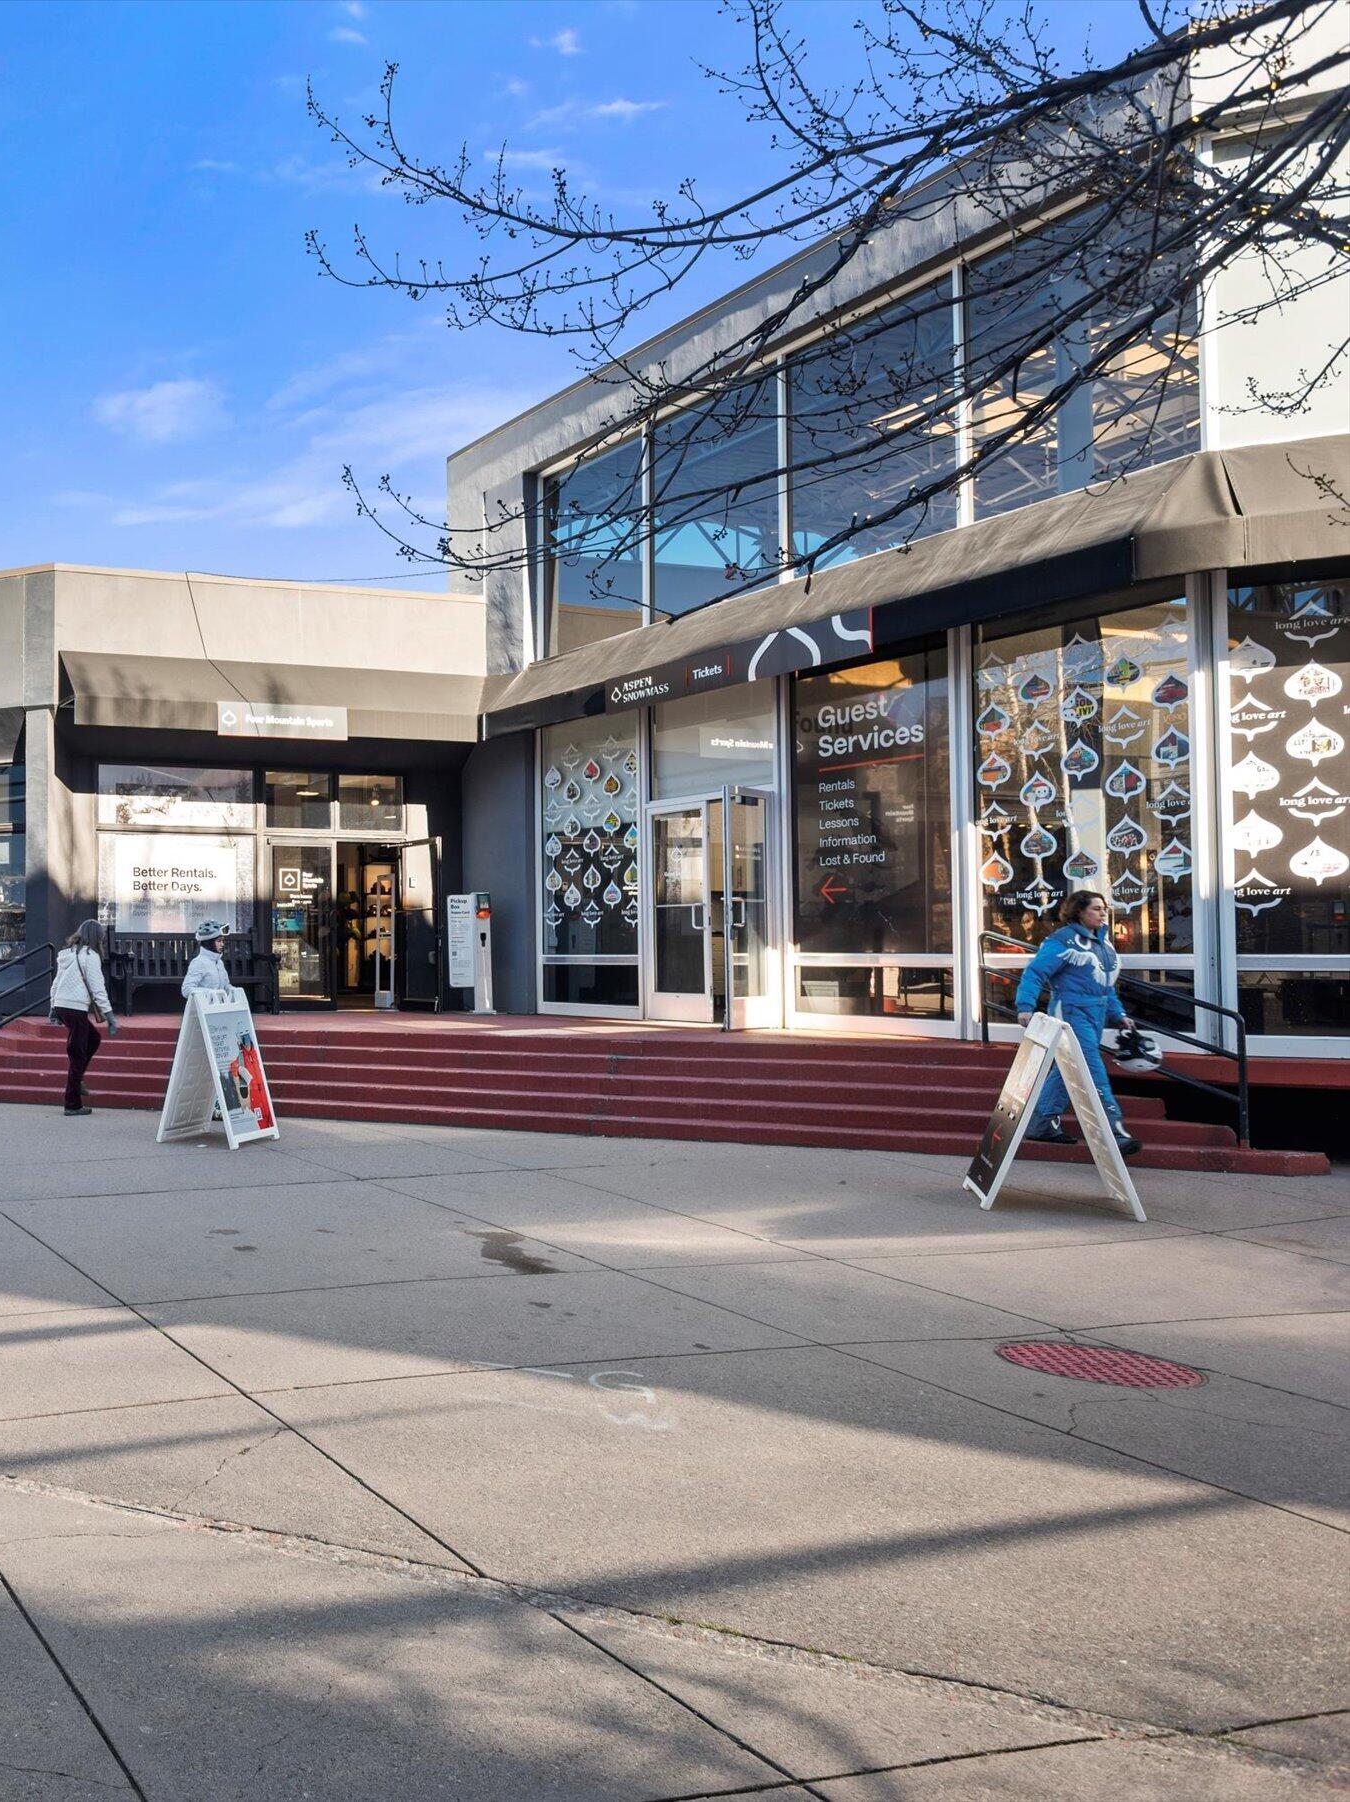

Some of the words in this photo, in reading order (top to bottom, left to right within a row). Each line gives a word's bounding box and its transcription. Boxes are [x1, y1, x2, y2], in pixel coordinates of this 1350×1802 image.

[1276, 622, 1300, 630] long
[1304, 618, 1327, 628] love
[692, 664, 722, 680] Tickets
[622, 676, 652, 692] ASPEN
[622, 683, 670, 704] SNOWMASS
[818, 695, 888, 728] Guest
[1242, 711, 1266, 720] love
[1268, 710, 1287, 718] art
[246, 714, 264, 724] Four
[266, 715, 305, 726] Mountain
[307, 717, 334, 728] Sports
[1098, 725, 1118, 734] long
[1118, 722, 1136, 730] love
[818, 724, 924, 758] Services
[818, 779, 856, 794] Rentals
[818, 798, 855, 811] Tickets
[1146, 801, 1166, 810] long
[1279, 797, 1306, 808] long
[1308, 796, 1332, 806] love
[819, 817, 860, 830] Lessons
[819, 834, 876, 848] Information
[820, 855, 841, 866] Lost
[842, 854, 850, 864] &
[853, 850, 886, 864] Found
[133, 866, 168, 878] Better
[171, 868, 218, 878] Rentals.
[133, 880, 168, 891] Better
[171, 882, 202, 893] Days.
[1246, 886, 1270, 896] love
[1272, 886, 1292, 895] art
[1016, 892, 1032, 900] long
